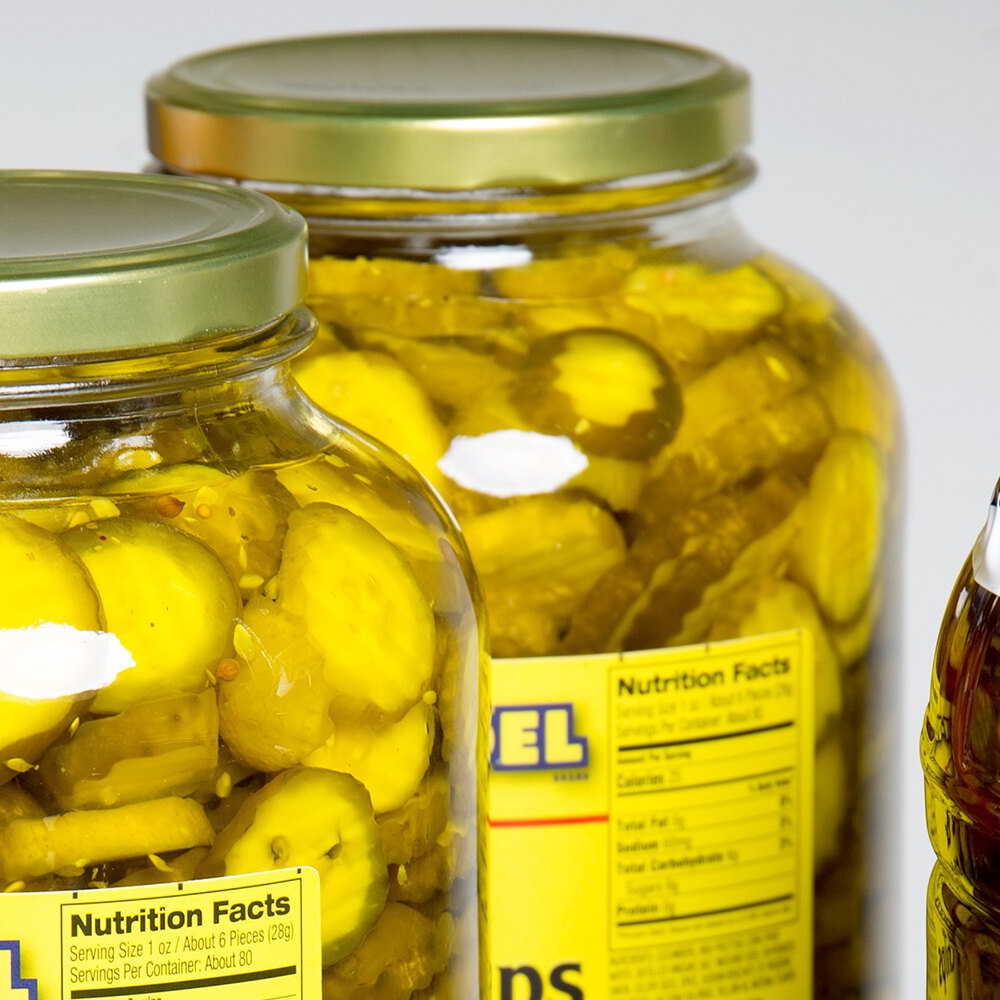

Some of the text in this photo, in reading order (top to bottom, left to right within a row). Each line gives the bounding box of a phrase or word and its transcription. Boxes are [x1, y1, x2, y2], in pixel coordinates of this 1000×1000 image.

[619, 668, 724, 696] Nutrition
[734, 656, 790, 681] Facts
[489, 703, 589, 771] EL
[71, 894, 291, 937] Nutrition Facts
[70, 943, 115, 962] Serving
[119, 942, 143, 958] Size
[149, 940, 153, 956] 1
[159, 941, 171, 954] oz
[183, 935, 215, 952] About
[219, 932, 226, 947] 6
[230, 928, 264, 946] Pieces
[268, 922, 294, 944] (28g)
[70, 950, 252, 984] Servings Per Container: About 80
